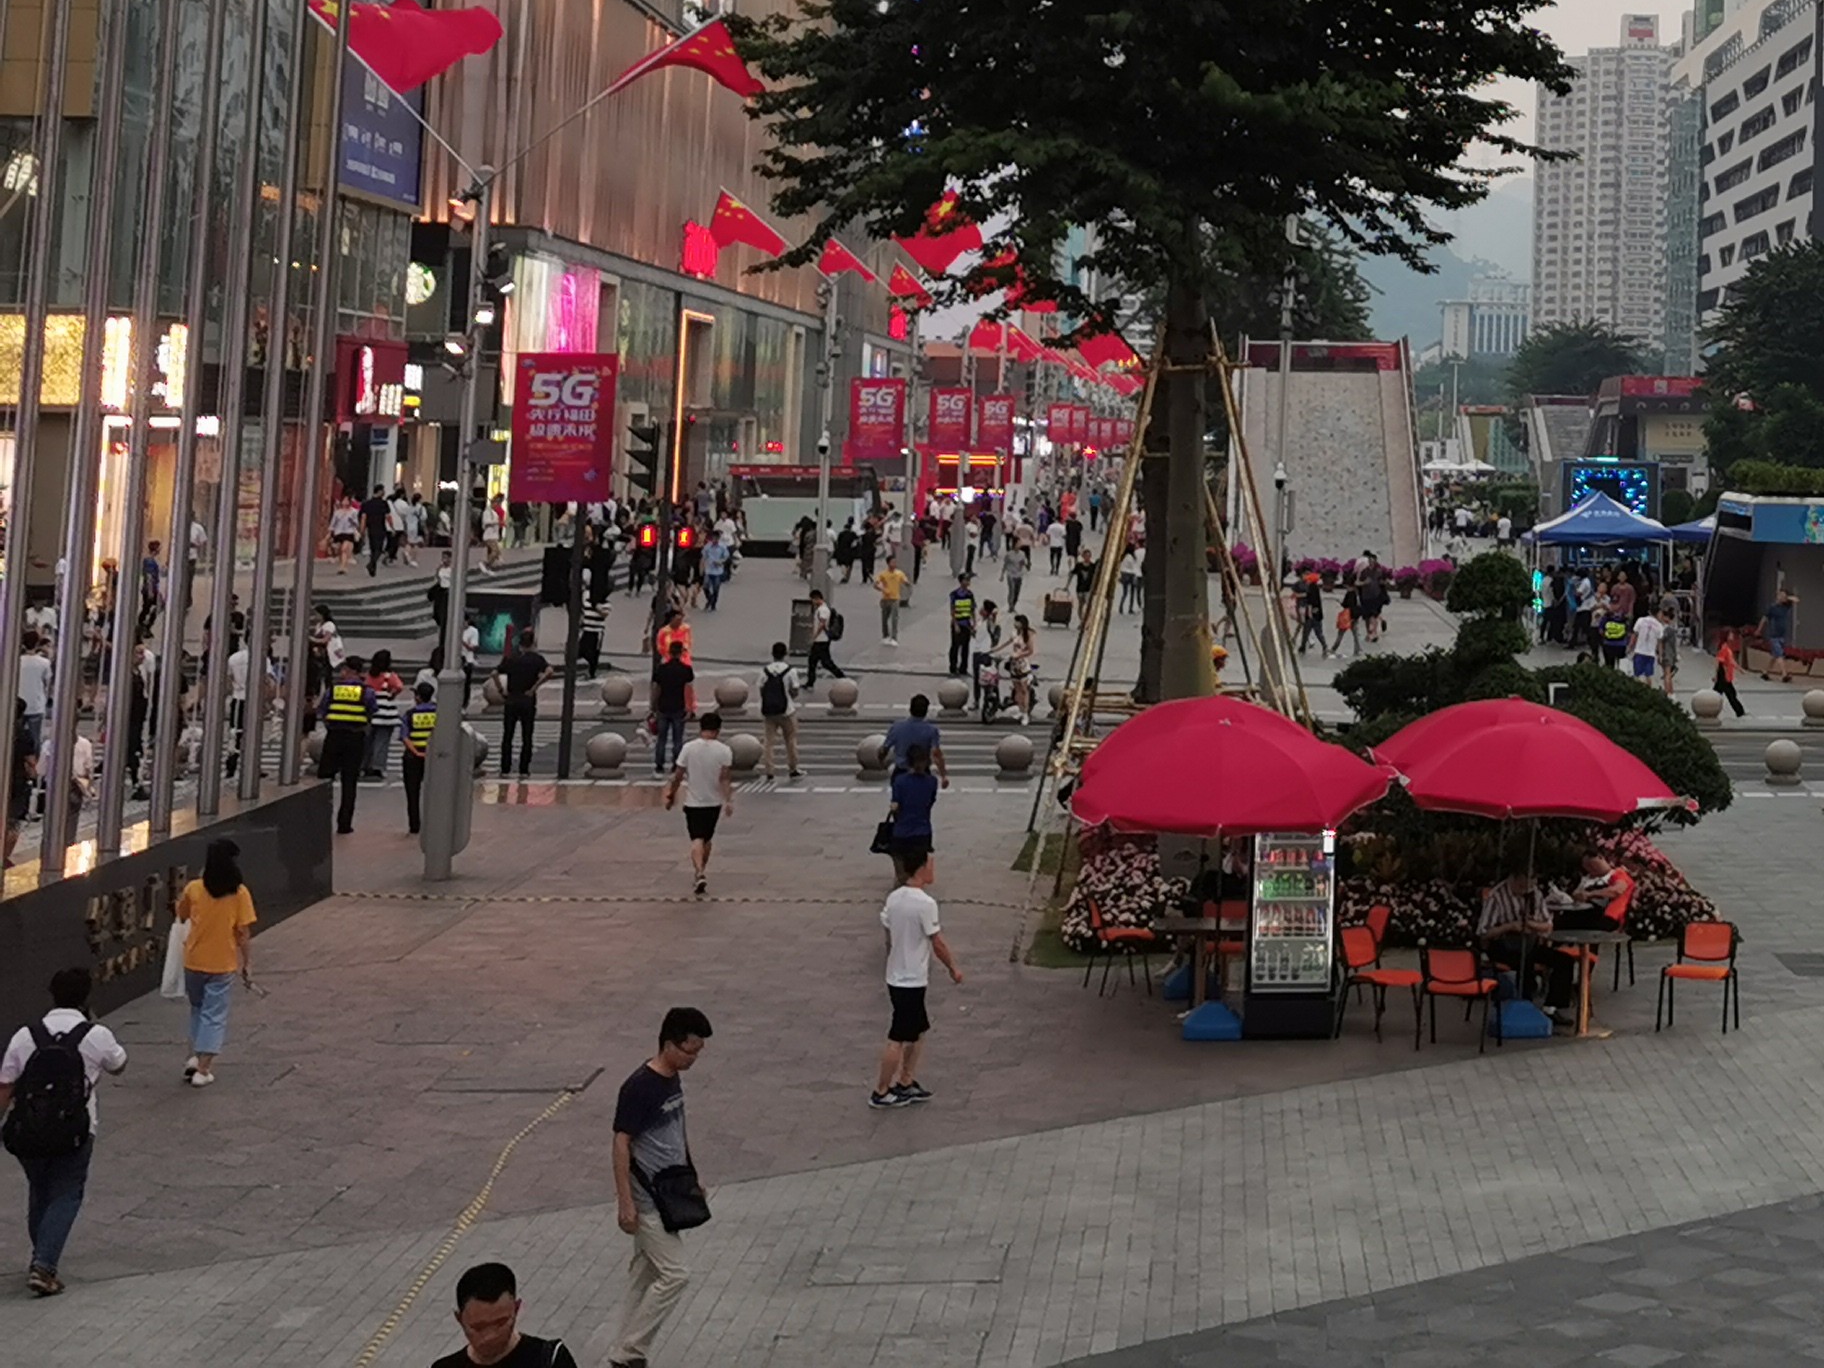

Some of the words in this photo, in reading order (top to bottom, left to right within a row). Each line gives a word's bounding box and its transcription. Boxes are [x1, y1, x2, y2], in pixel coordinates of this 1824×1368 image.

[528, 373, 598, 406] 5G
[859, 387, 897, 408] 5G
[936, 394, 966, 411] 5G
[984, 400, 1009, 415] 5G
